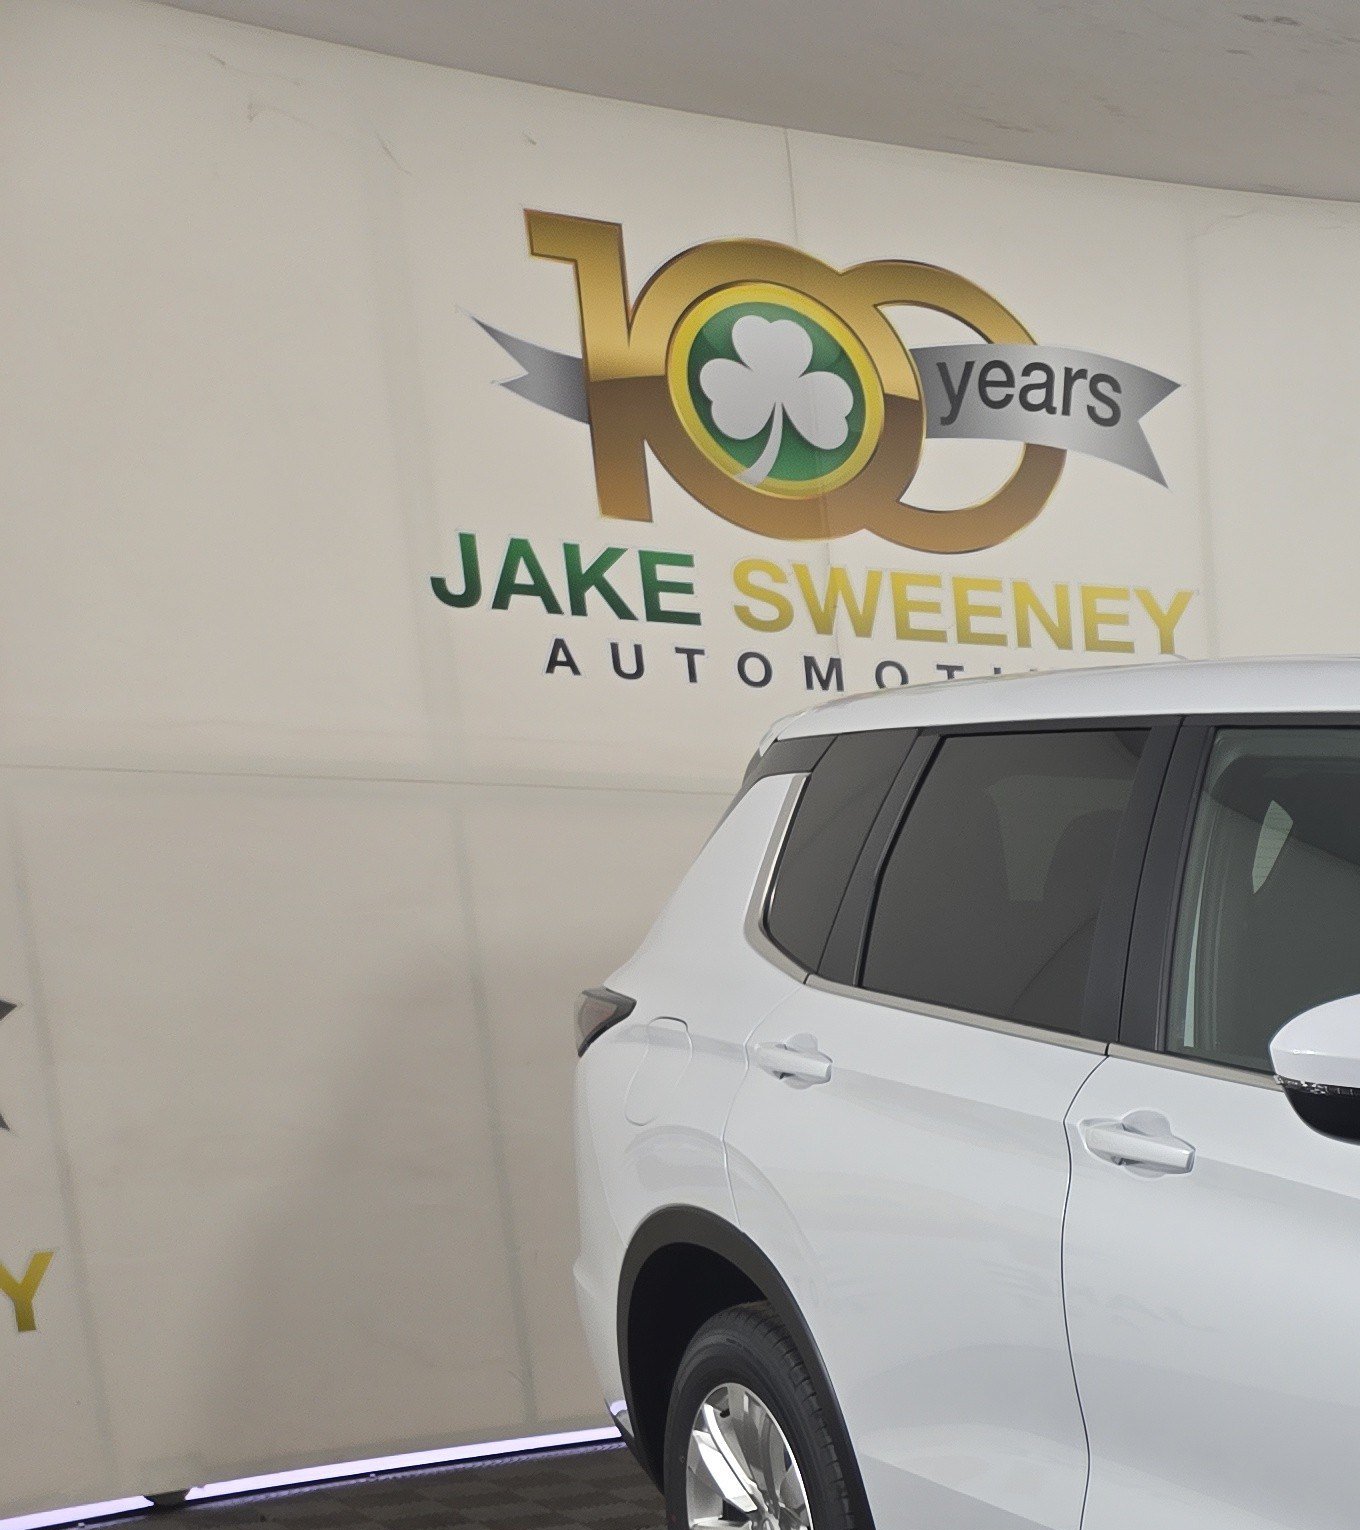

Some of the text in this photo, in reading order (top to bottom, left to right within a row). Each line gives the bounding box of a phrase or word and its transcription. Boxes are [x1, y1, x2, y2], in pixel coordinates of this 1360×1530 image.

[524, 208, 1067, 555] 100
[935, 358, 1123, 428] years
[430, 532, 1194, 656] JAKE SWEENEY
